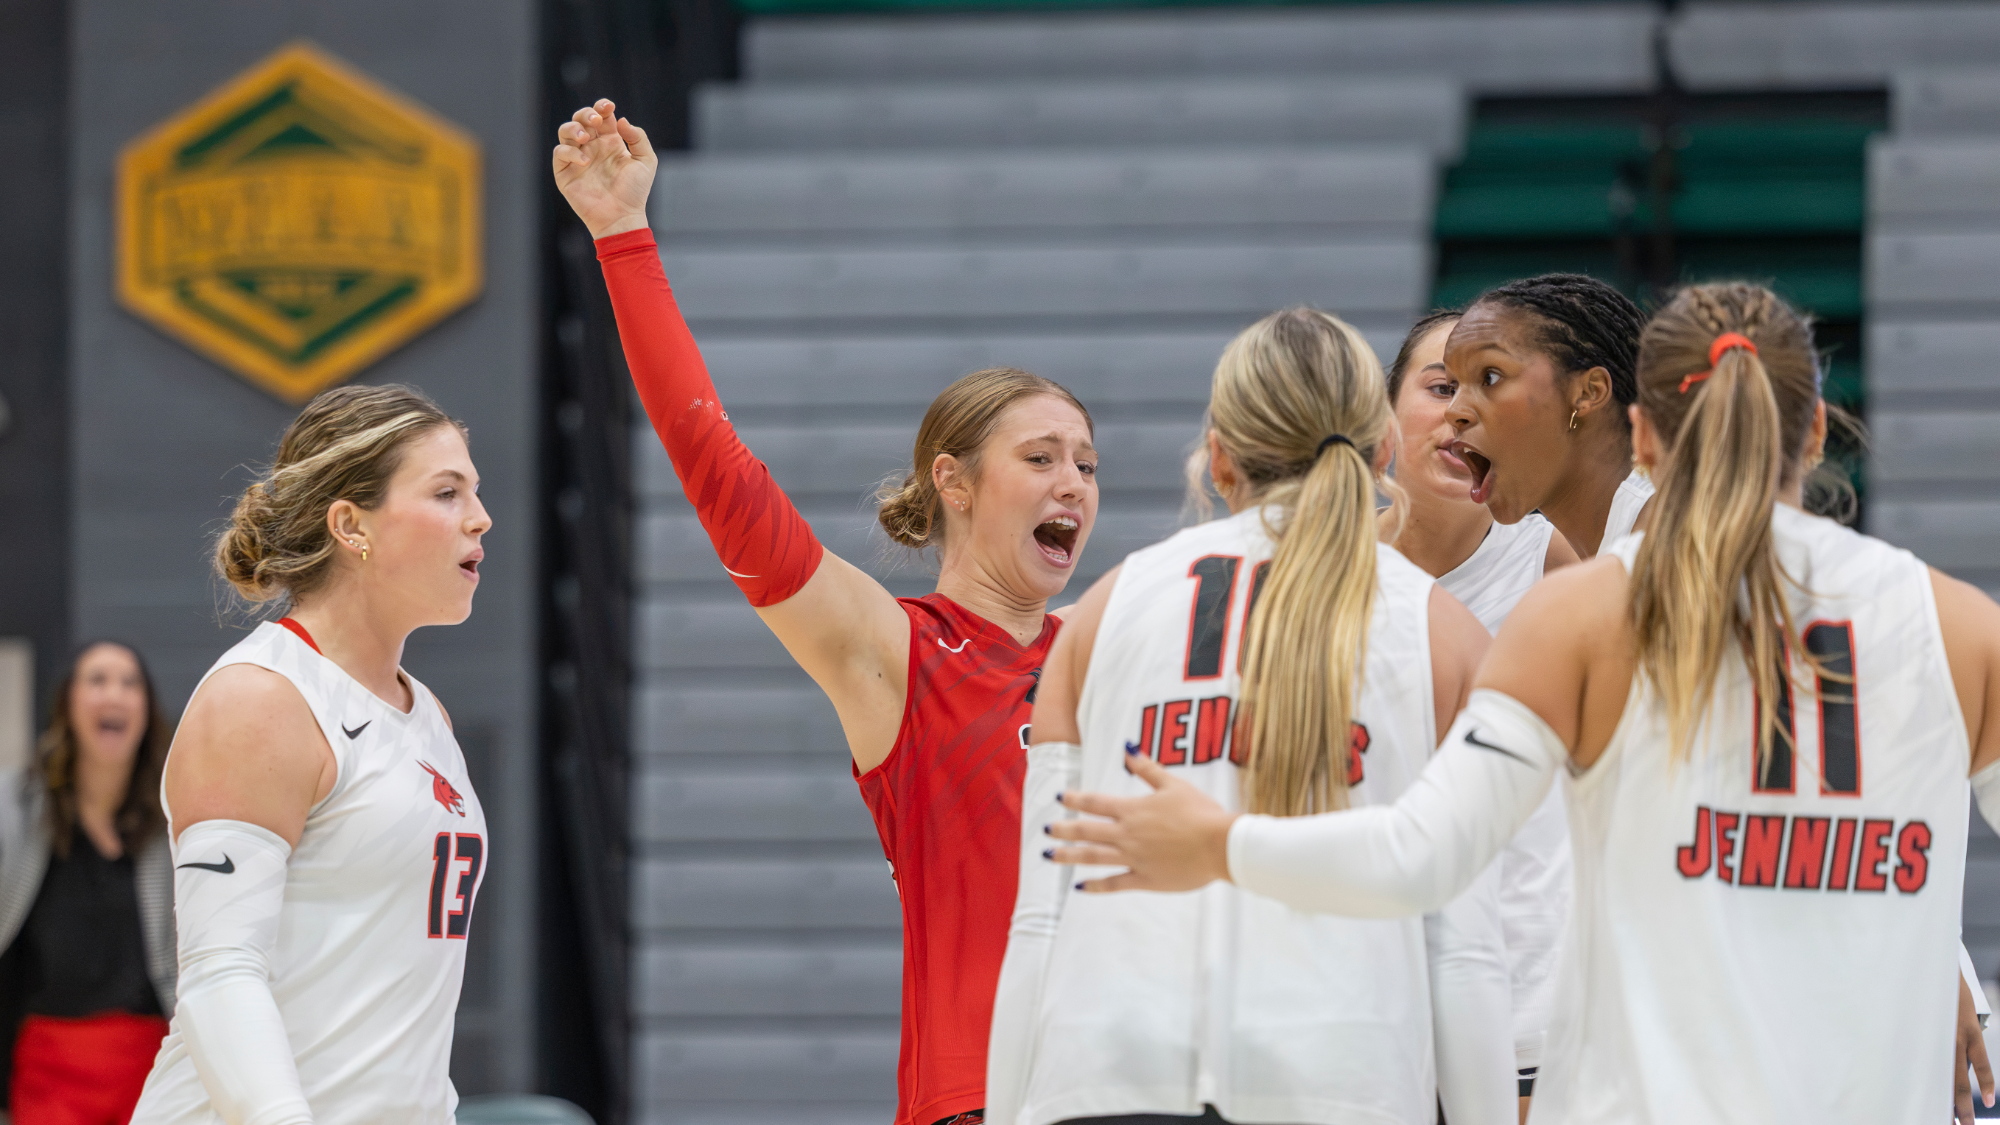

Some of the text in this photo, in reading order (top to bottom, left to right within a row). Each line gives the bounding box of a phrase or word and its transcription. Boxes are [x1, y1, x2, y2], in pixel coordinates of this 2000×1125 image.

[1743, 620, 1861, 798] 11
[428, 832, 484, 939] 13
[1676, 806, 1932, 893] JENNIES
